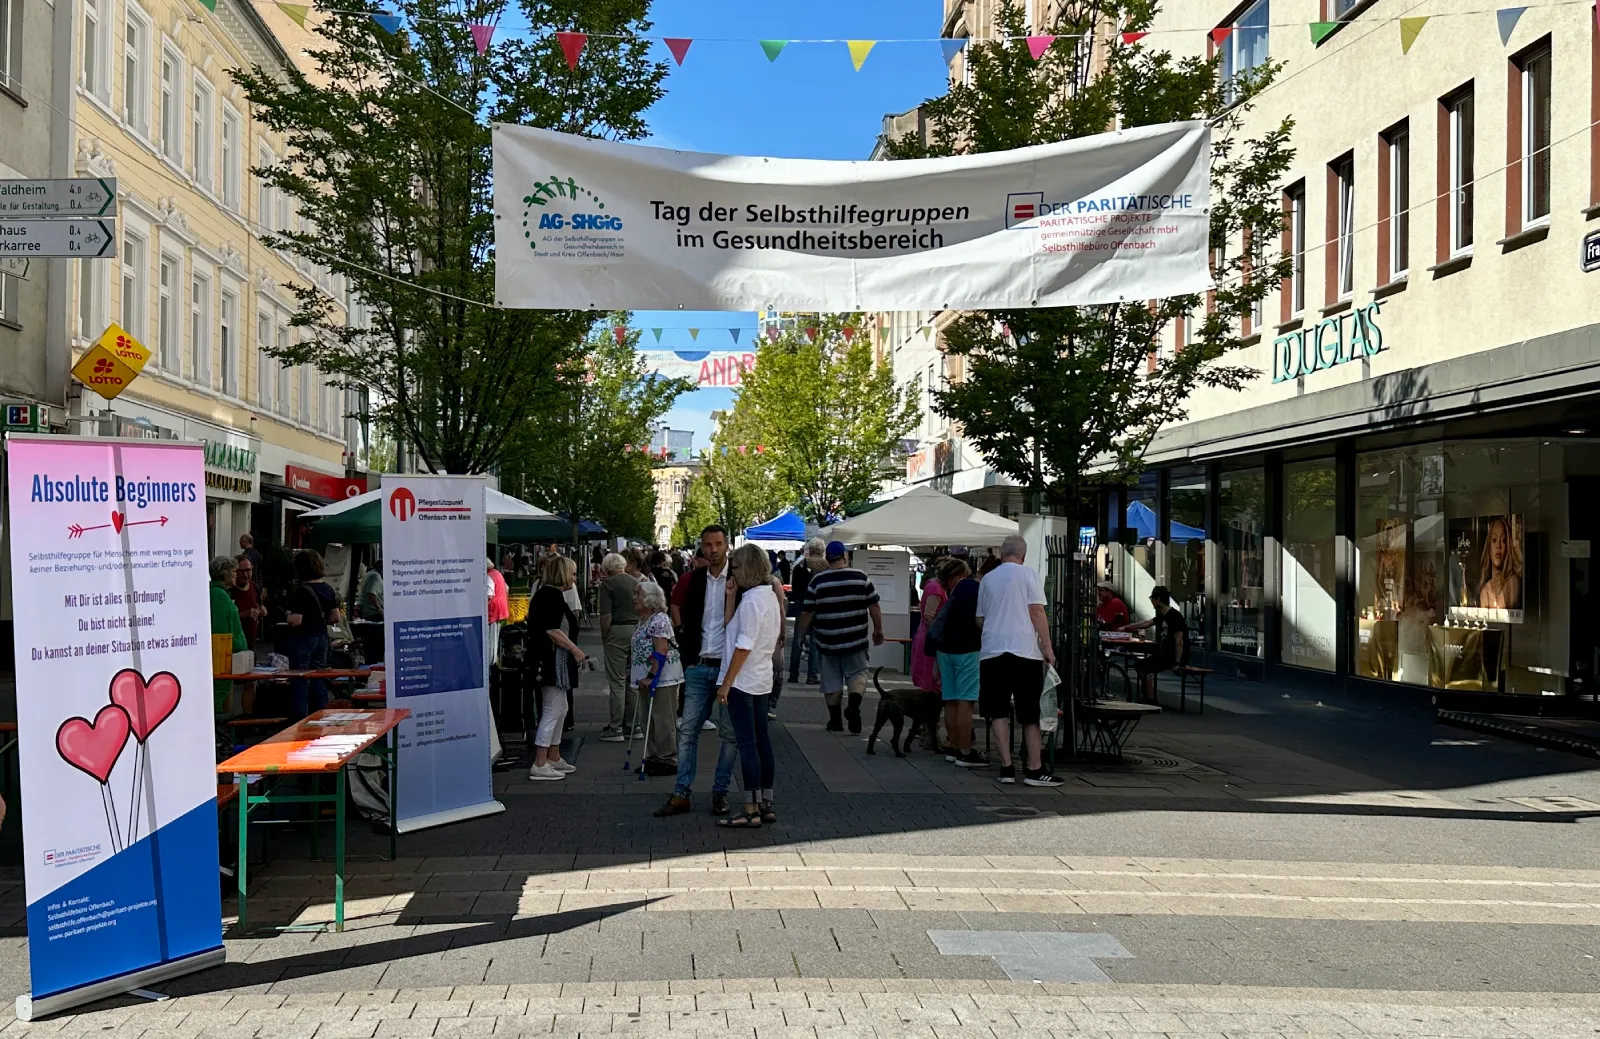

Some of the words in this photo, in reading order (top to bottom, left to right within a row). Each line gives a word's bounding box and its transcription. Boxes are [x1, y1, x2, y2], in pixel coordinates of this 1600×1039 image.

[0, 184, 46, 195] aldheim
[69, 184, 82, 195] 4.0
[9, 202, 20, 211] für
[22, 201, 59, 211] Gestaltung
[70, 199, 82, 209] 0.6
[1039, 203, 1073, 216] DER
[1077, 192, 1192, 214] PARITÄTISCHE
[649, 200, 691, 225] Tag
[698, 201, 739, 222] der
[745, 203, 970, 227] Selbsthilfegruppen
[1040, 215, 1108, 228] PARITÄTISCHE
[1110, 213, 1152, 223] PROJEKTE
[538, 212, 623, 231] AG-SHGiG
[69, 225, 81, 236] 0.4
[1040, 227, 1107, 240] gemeinnützige
[1108, 226, 1155, 236] Gesellschaft
[1157, 225, 1178, 235] mbH
[69, 240, 81, 251] 0.4
[564, 235, 616, 243] Selbsthilfegruppen
[676, 229, 705, 248] im
[712, 228, 944, 250] Gesundheitsbereich
[1042, 242, 1109, 252] Selbsthilfebüro
[1110, 240, 1156, 250] Offenbach
[1272, 301, 1383, 384] DOUGLAS
[115, 349, 143, 361] LOTTO
[89, 374, 123, 386] LOTTO
[31, 474, 109, 503] Absolute
[115, 475, 197, 509] Beginners
[418, 499, 464, 507] Pflegestützpunkt
[418, 513, 448, 521] Offenbach
[458, 513, 471, 521] Main
[28, 551, 92, 562] Selbsthilfegruppe
[92, 550, 102, 558] für
[104, 549, 138, 558] Menschen
[139, 549, 151, 557] mit
[151, 549, 172, 558] wenig
[173, 548, 183, 556] bis
[184, 548, 195, 557] gar
[29, 563, 53, 574] keiner
[54, 562, 98, 573] Beziehungs-
[98, 561, 129, 571] und/oder
[131, 560, 160, 570] sexueller
[64, 594, 77, 608] Mit
[79, 594, 91, 607] Dir
[92, 592, 103, 606] ist
[104, 592, 122, 605] alles
[124, 591, 132, 604] in
[133, 589, 166, 605] Ordnung!
[78, 618, 89, 632] Du
[90, 617, 106, 631] bist
[107, 616, 127, 630] nicht
[128, 613, 155, 628] alleine!
[31, 647, 43, 661] Du
[44, 646, 73, 660] kannst
[74, 647, 84, 657] an
[85, 643, 110, 656] deiner
[111, 639, 145, 654] Situation
[147, 638, 169, 650] etwas
[170, 632, 198, 648] ändern!
[88, 899, 115, 912] Offenbach
